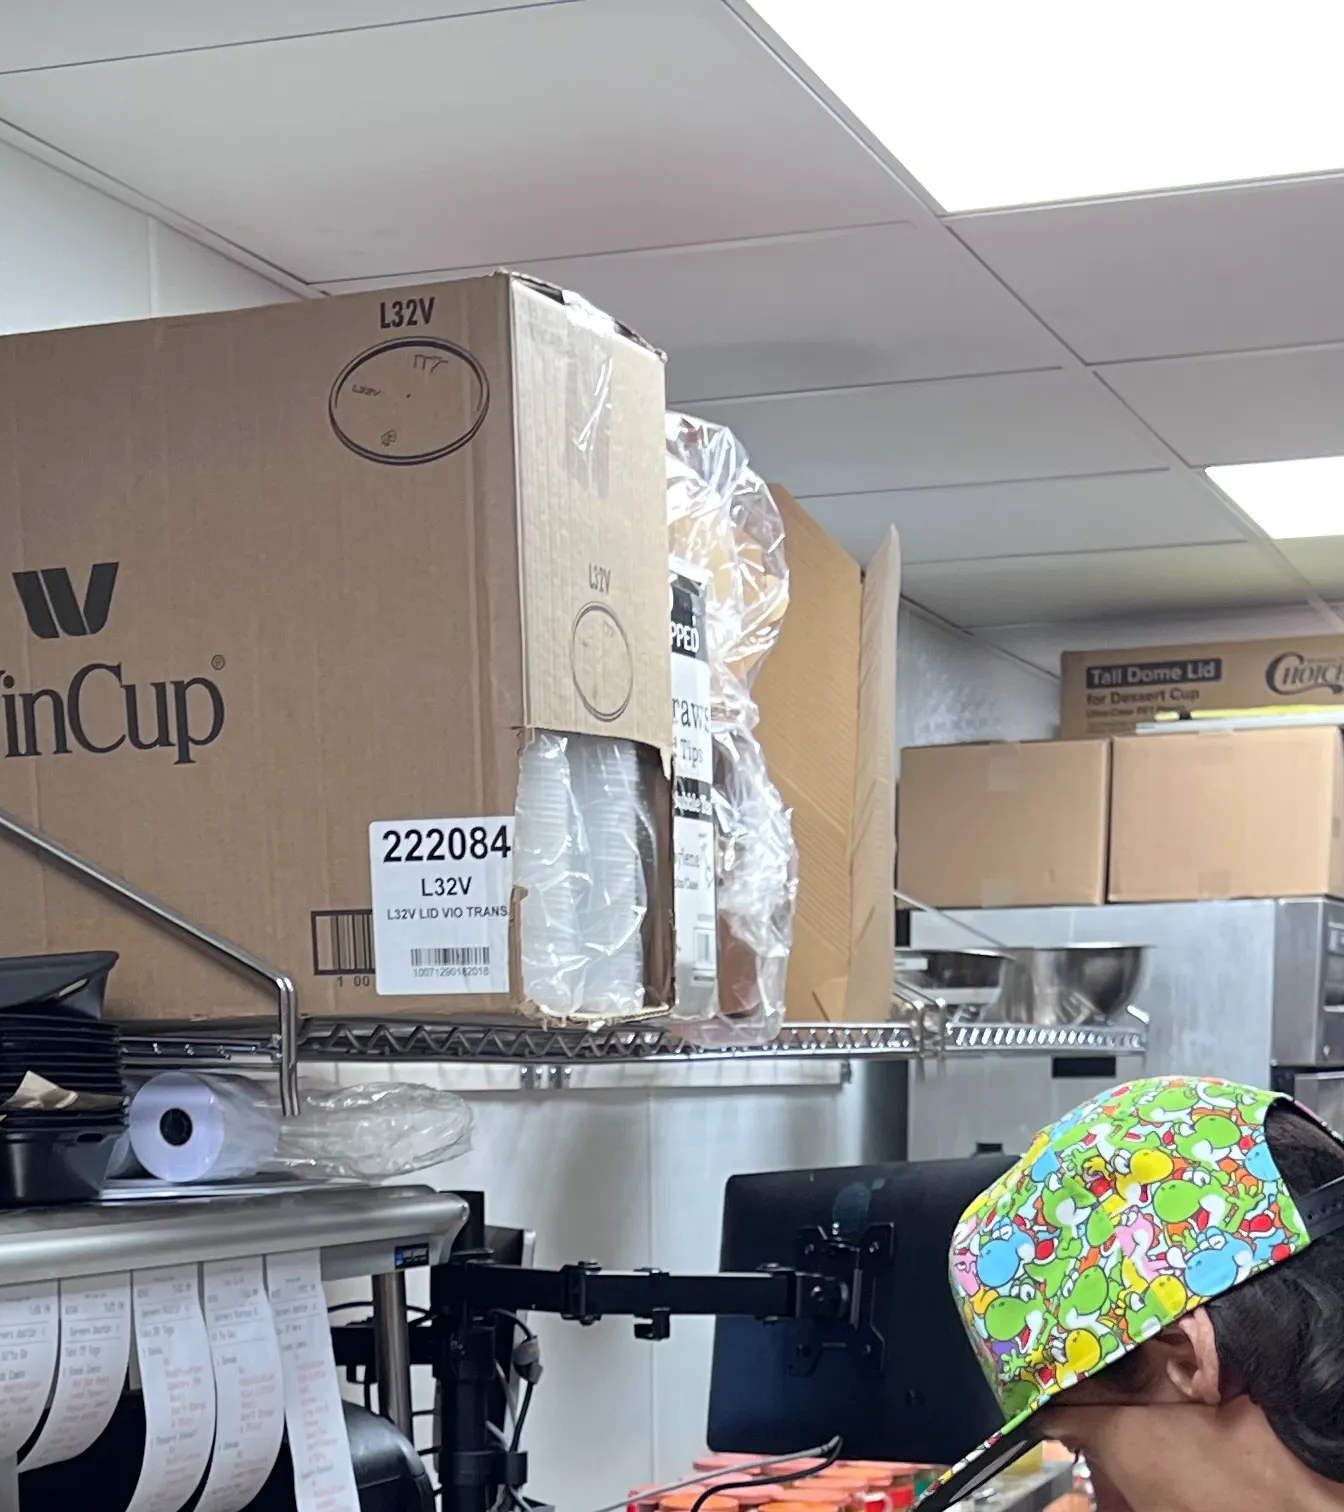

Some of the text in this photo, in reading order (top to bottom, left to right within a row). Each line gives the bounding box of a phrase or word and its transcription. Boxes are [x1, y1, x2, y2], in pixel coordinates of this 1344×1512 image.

[380, 297, 435, 328] L32V
[1091, 661, 1216, 686] Tall Dome Lid
[1111, 688, 1166, 704] Dessert
[1169, 687, 1199, 703] Cup
[382, 825, 511, 863] 222084
[421, 876, 472, 897] L32V
[387, 905, 508, 920] L32V LID VIO TRANS
